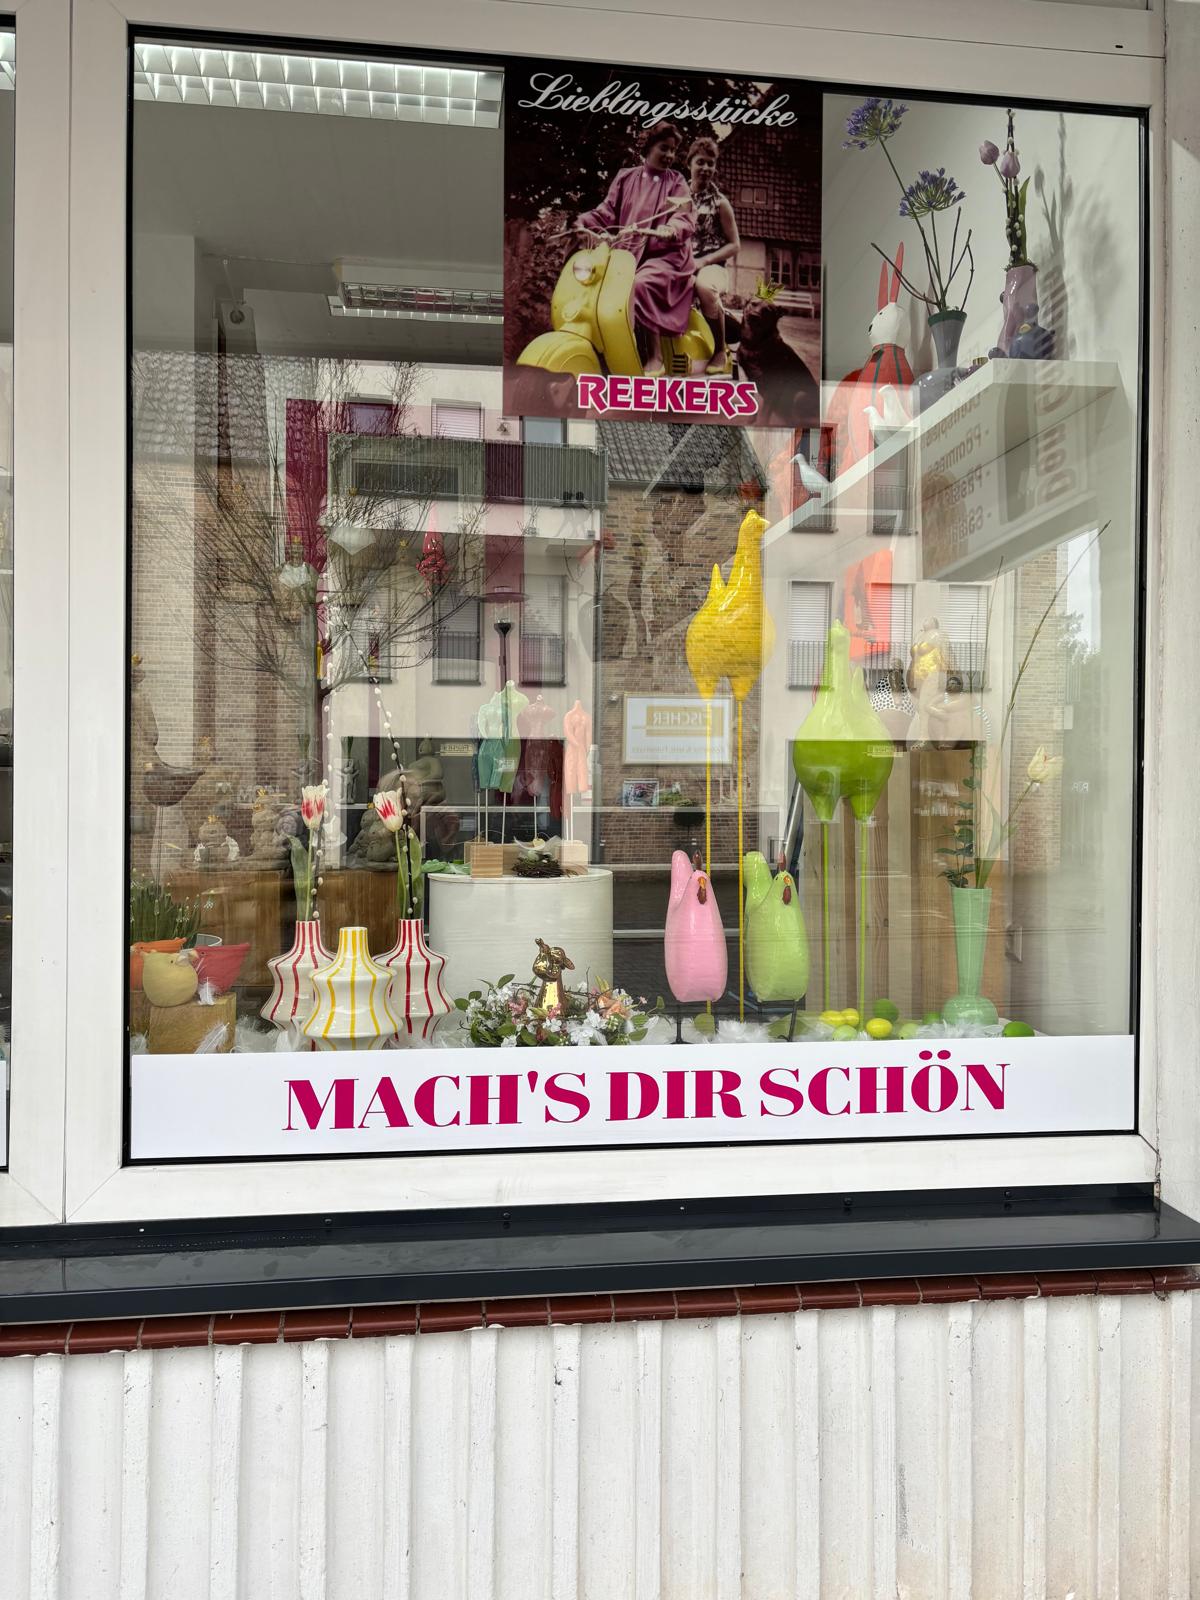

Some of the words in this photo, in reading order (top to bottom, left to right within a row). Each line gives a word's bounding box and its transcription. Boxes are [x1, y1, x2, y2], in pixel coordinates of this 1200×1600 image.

[518, 73, 797, 128] Lieblingsstücke
[578, 374, 758, 419] REEKERS
[282, 1070, 590, 1131] MACH'S
[605, 1070, 747, 1121] DIR
[759, 1050, 1010, 1117] SCHÖN
